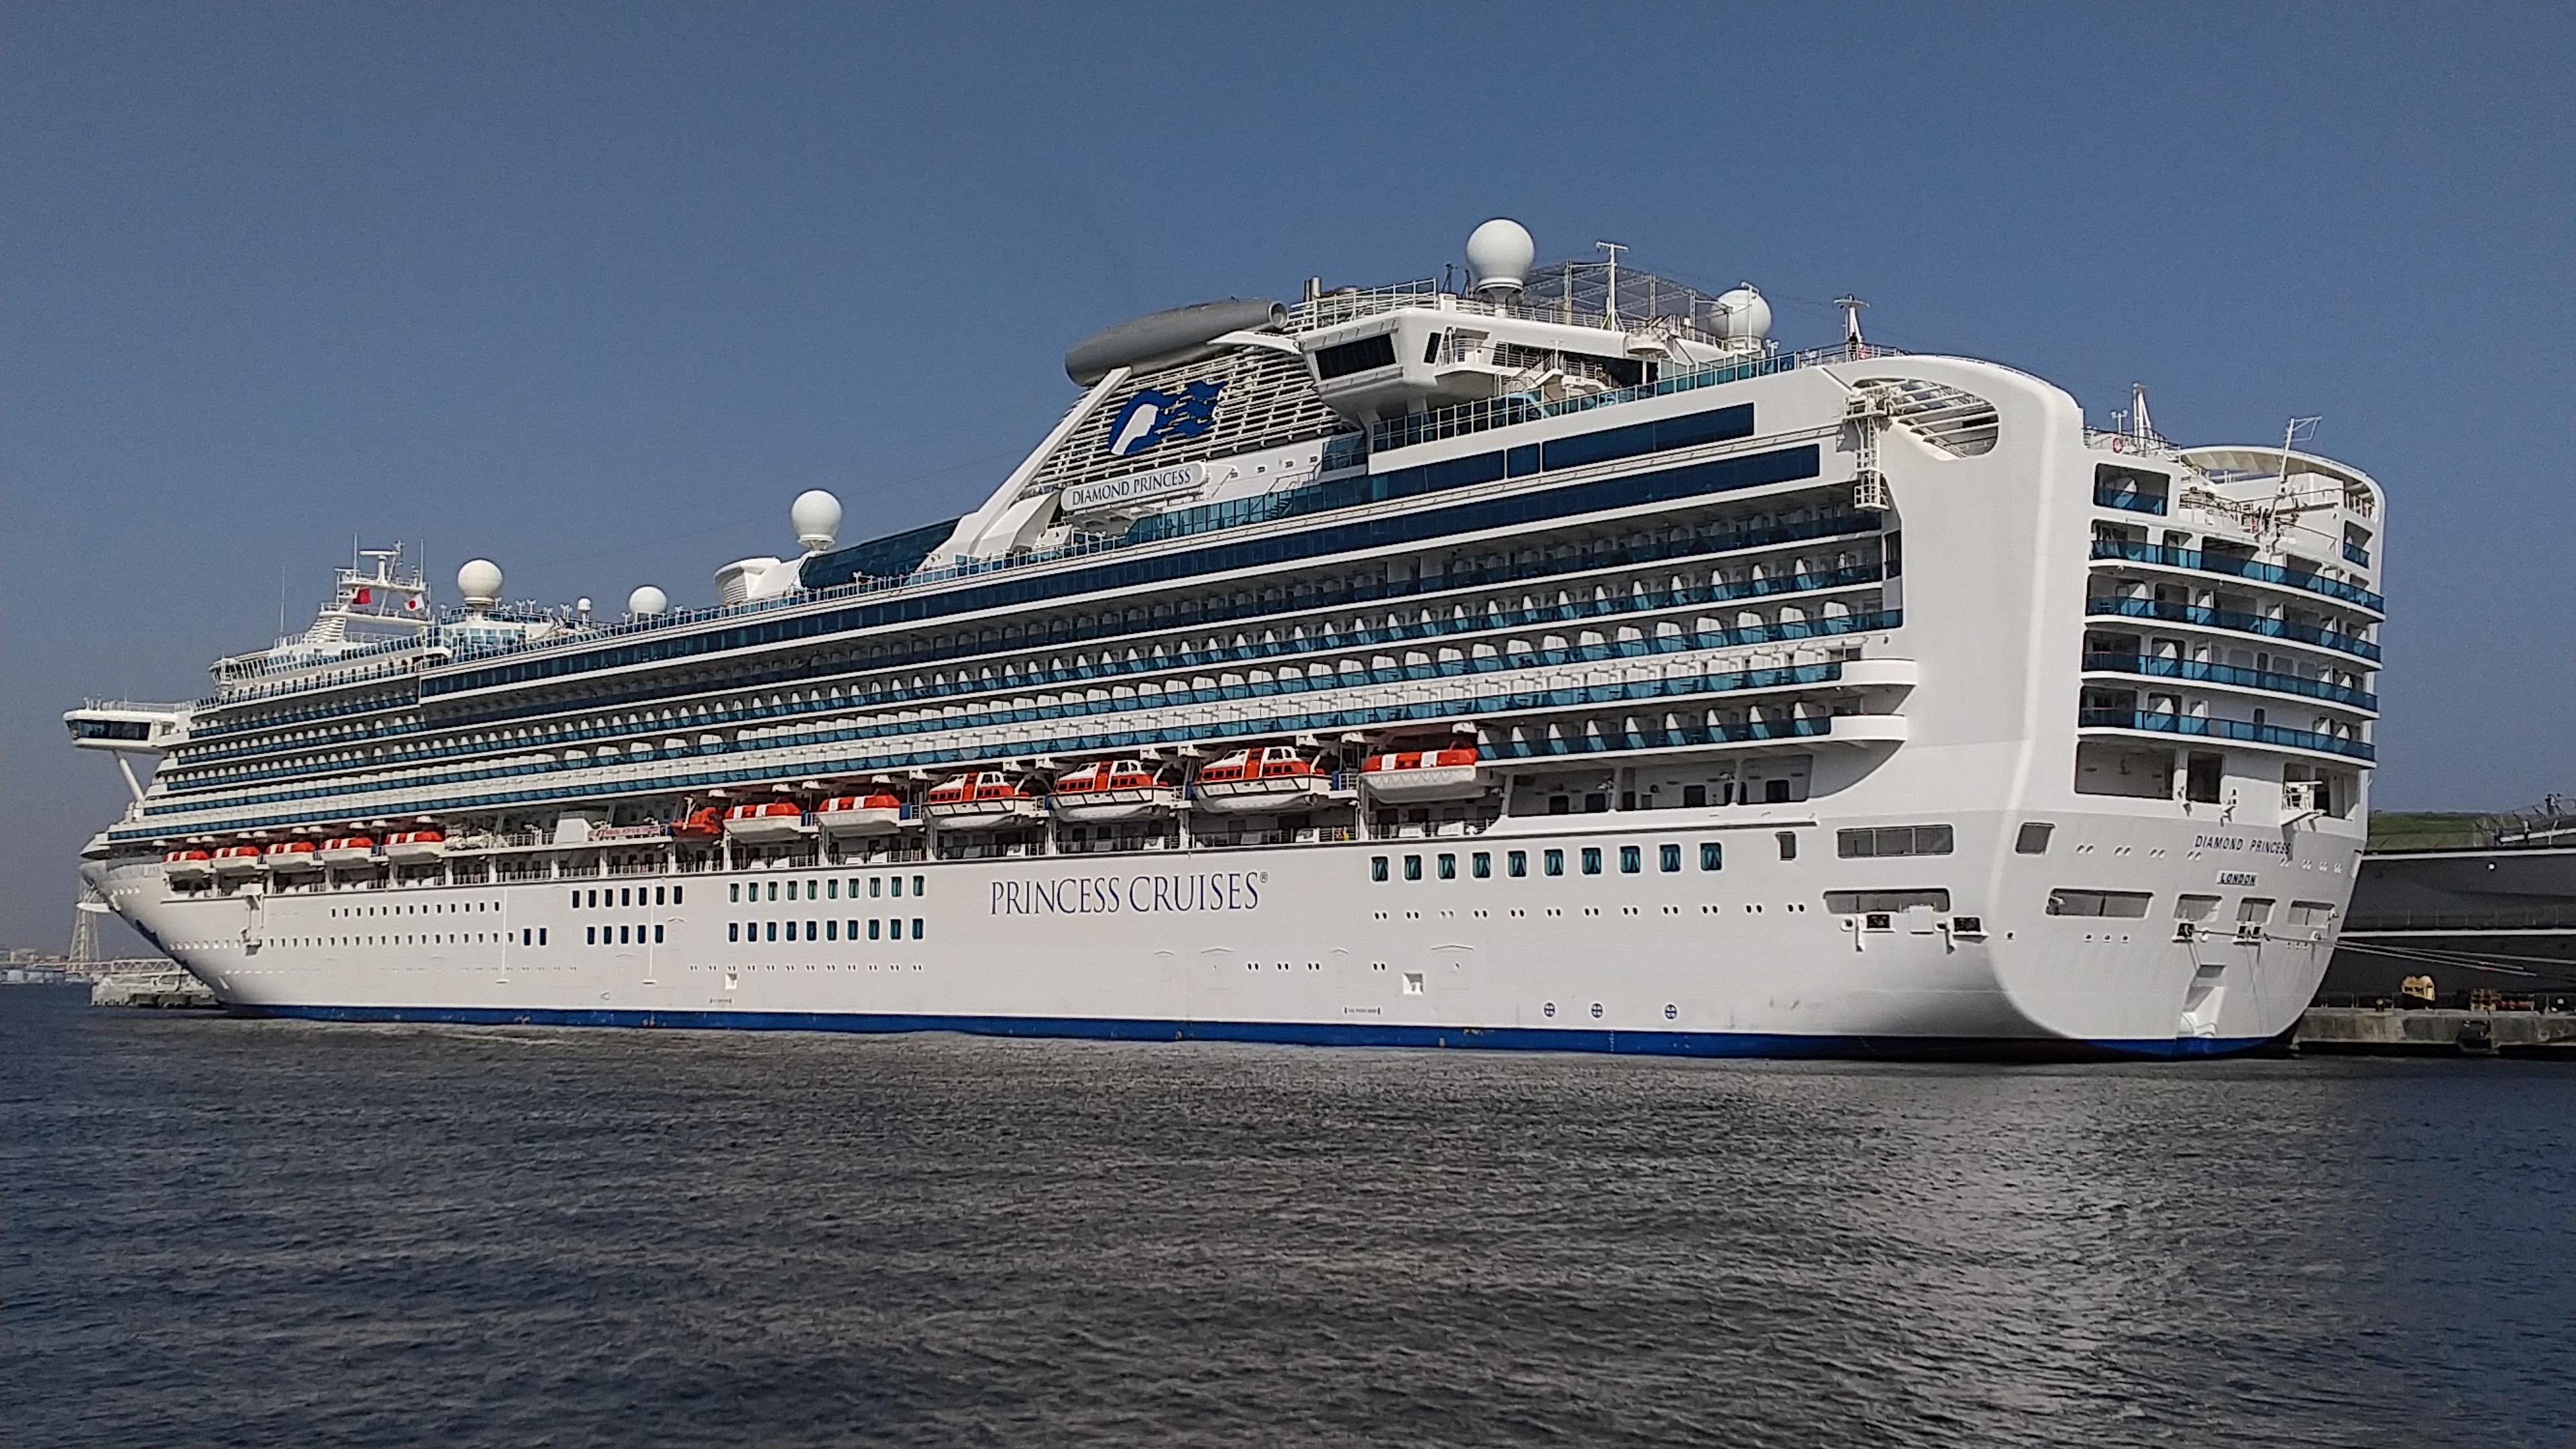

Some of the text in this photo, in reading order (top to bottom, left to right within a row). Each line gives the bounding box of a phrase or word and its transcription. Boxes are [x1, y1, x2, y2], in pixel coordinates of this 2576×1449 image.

[1073, 468, 1191, 505] DIAMOND PRINCESS
[2194, 835, 2292, 855] DIAMOND PRINCESS
[2220, 872, 2258, 884] LONDON
[990, 877, 1120, 915] PRINCESS
